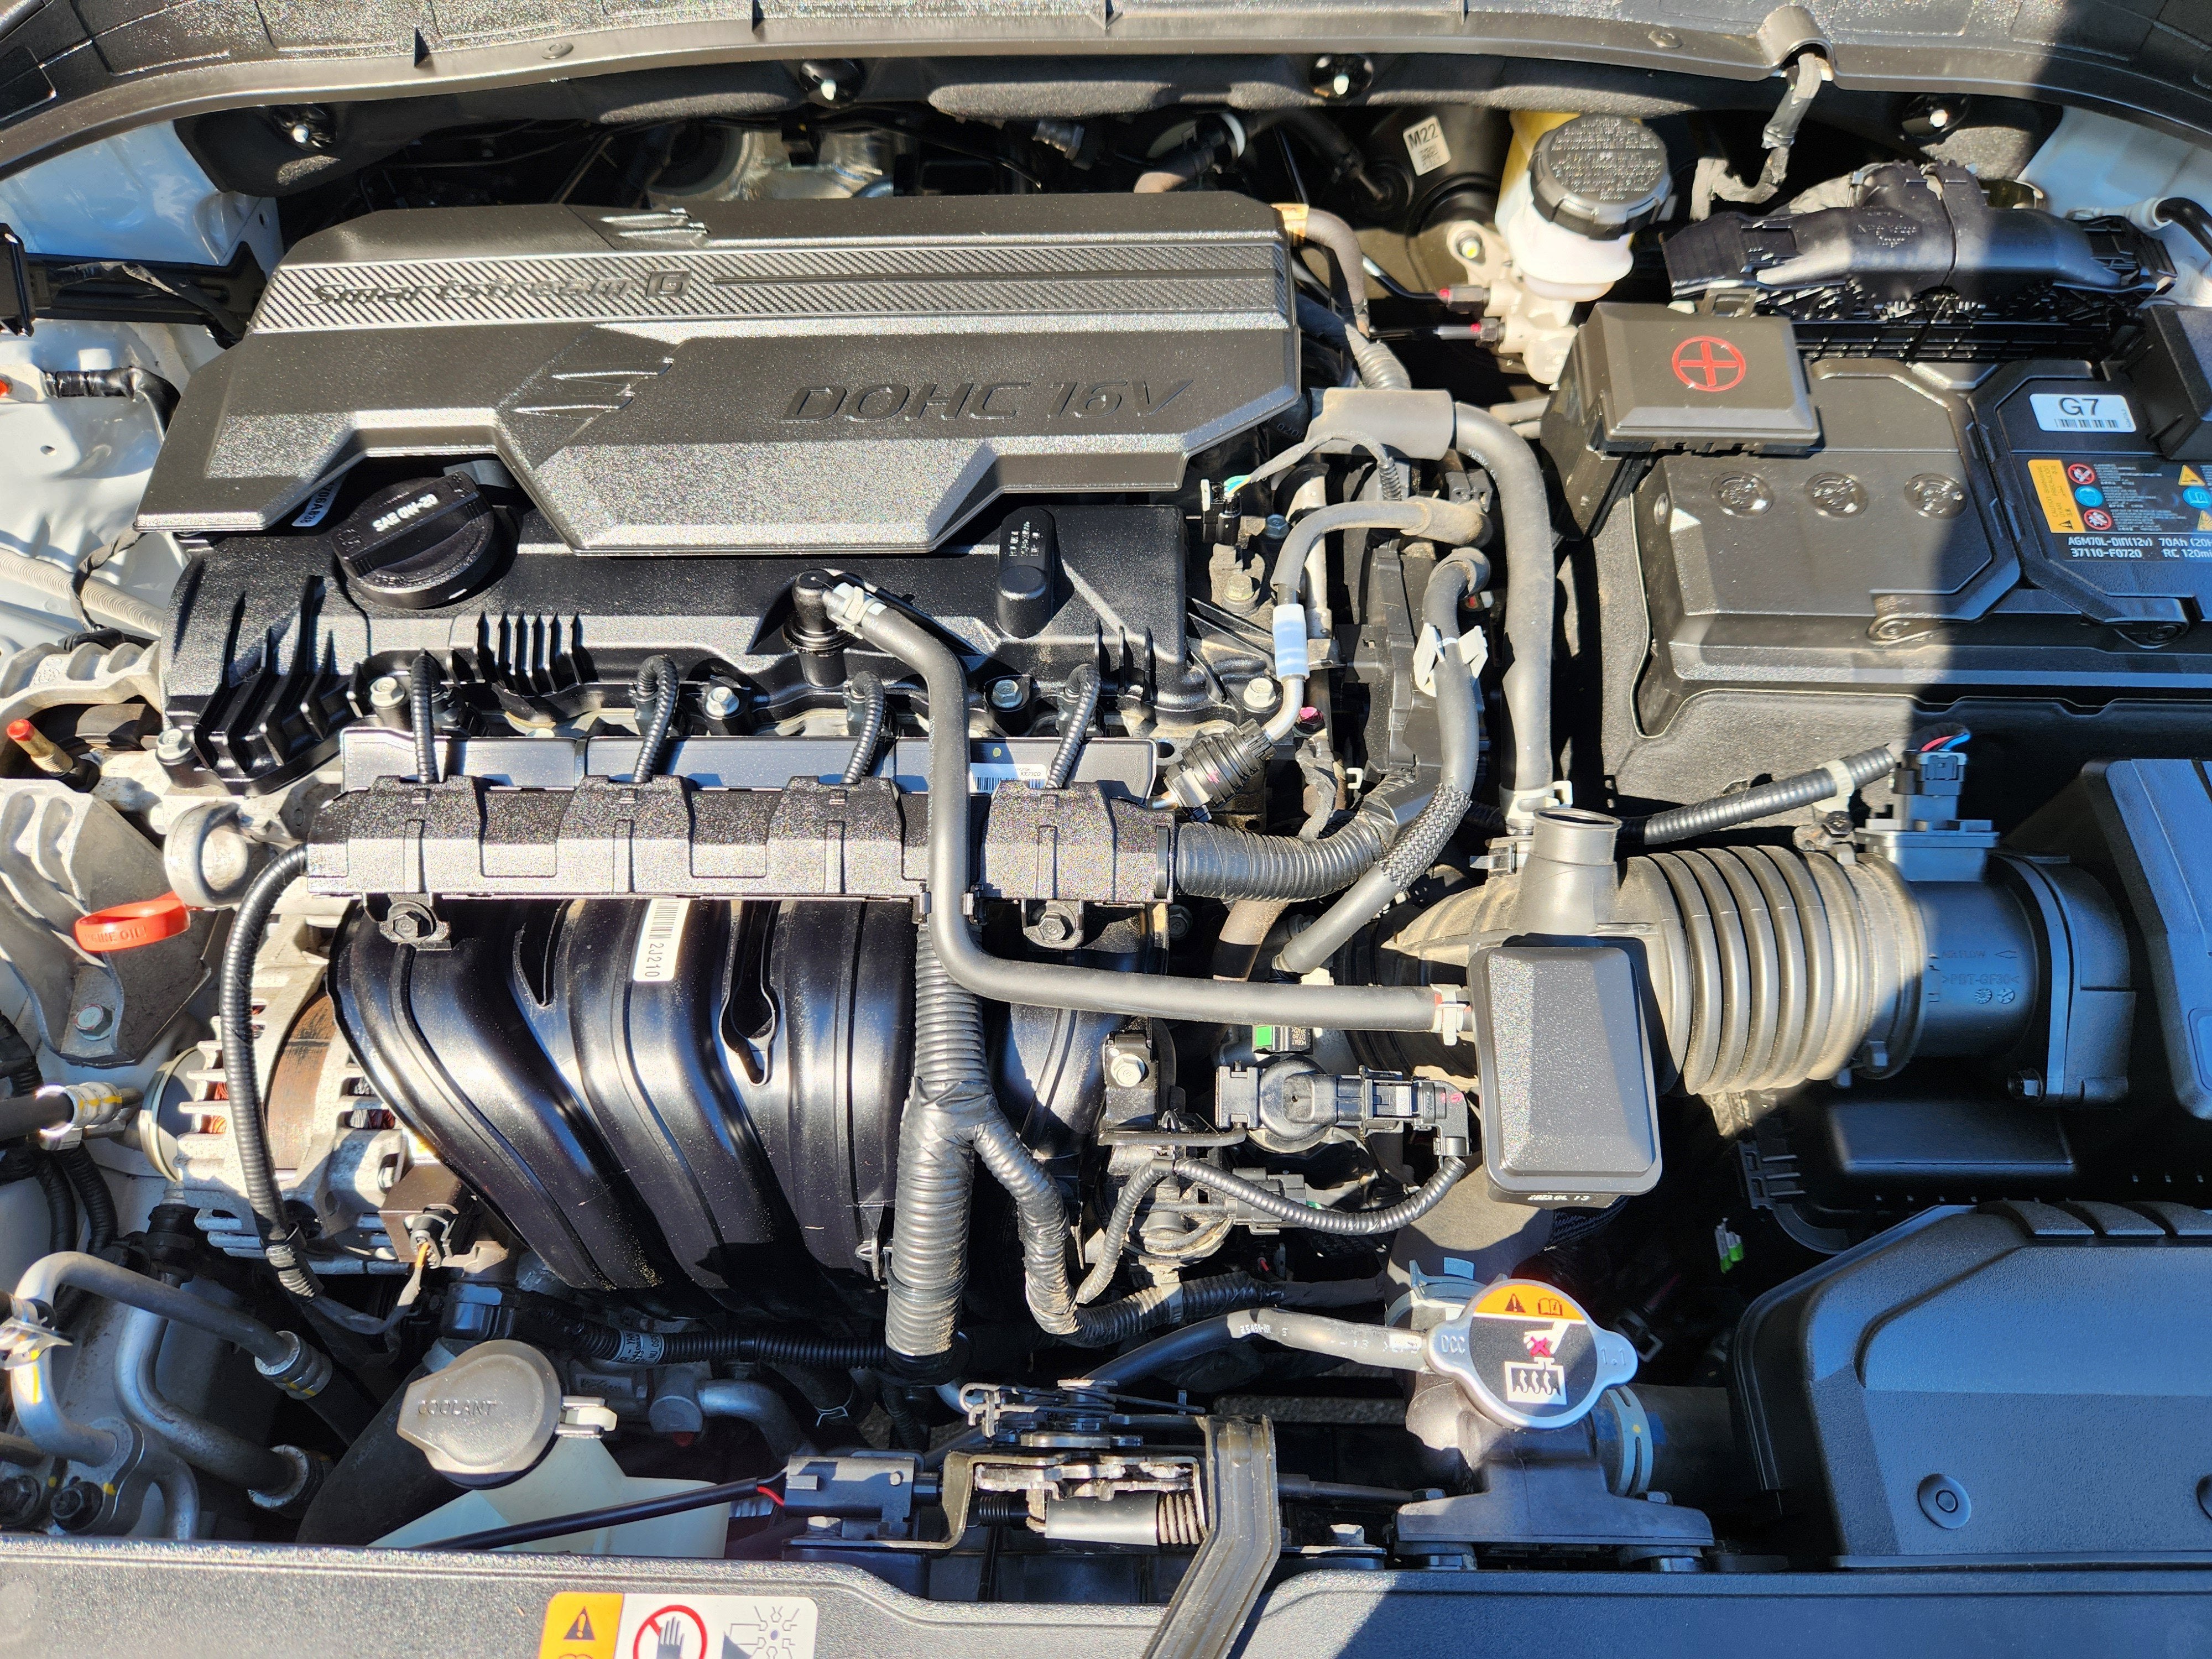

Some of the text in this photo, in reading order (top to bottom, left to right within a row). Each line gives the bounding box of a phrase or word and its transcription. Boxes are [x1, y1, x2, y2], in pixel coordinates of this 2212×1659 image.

[1406, 126, 1440, 150] M22
[781, 379, 1194, 424] DOHC 16V
[2059, 397, 2099, 416] G7
[372, 493, 439, 533] SAE 0W-20
[2070, 547, 2143, 559] 37110-F0720
[2163, 548, 2180, 559] RC
[2158, 537, 2188, 547] 70Ah
[644, 942, 665, 979] 2J210
[1441, 1335, 1465, 1354] DCC
[1600, 1346, 1626, 1366] 1.1
[418, 1399, 497, 1416] COOLANT
